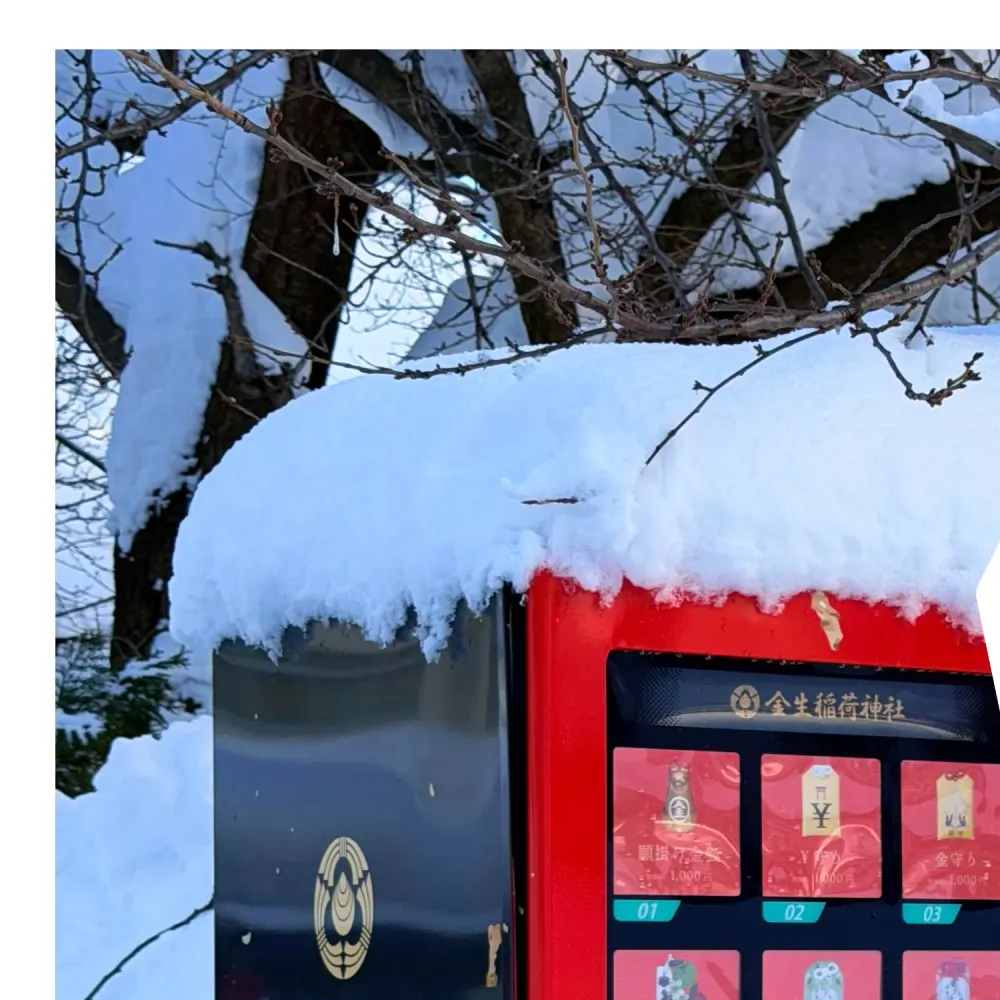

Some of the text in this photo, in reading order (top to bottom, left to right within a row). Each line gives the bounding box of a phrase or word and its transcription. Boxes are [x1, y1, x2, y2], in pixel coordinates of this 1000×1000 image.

[765, 690, 906, 722] 金生稲荷神社
[637, 902, 658, 920] 01
[784, 904, 805, 921] 02
[923, 906, 942, 922] 03
